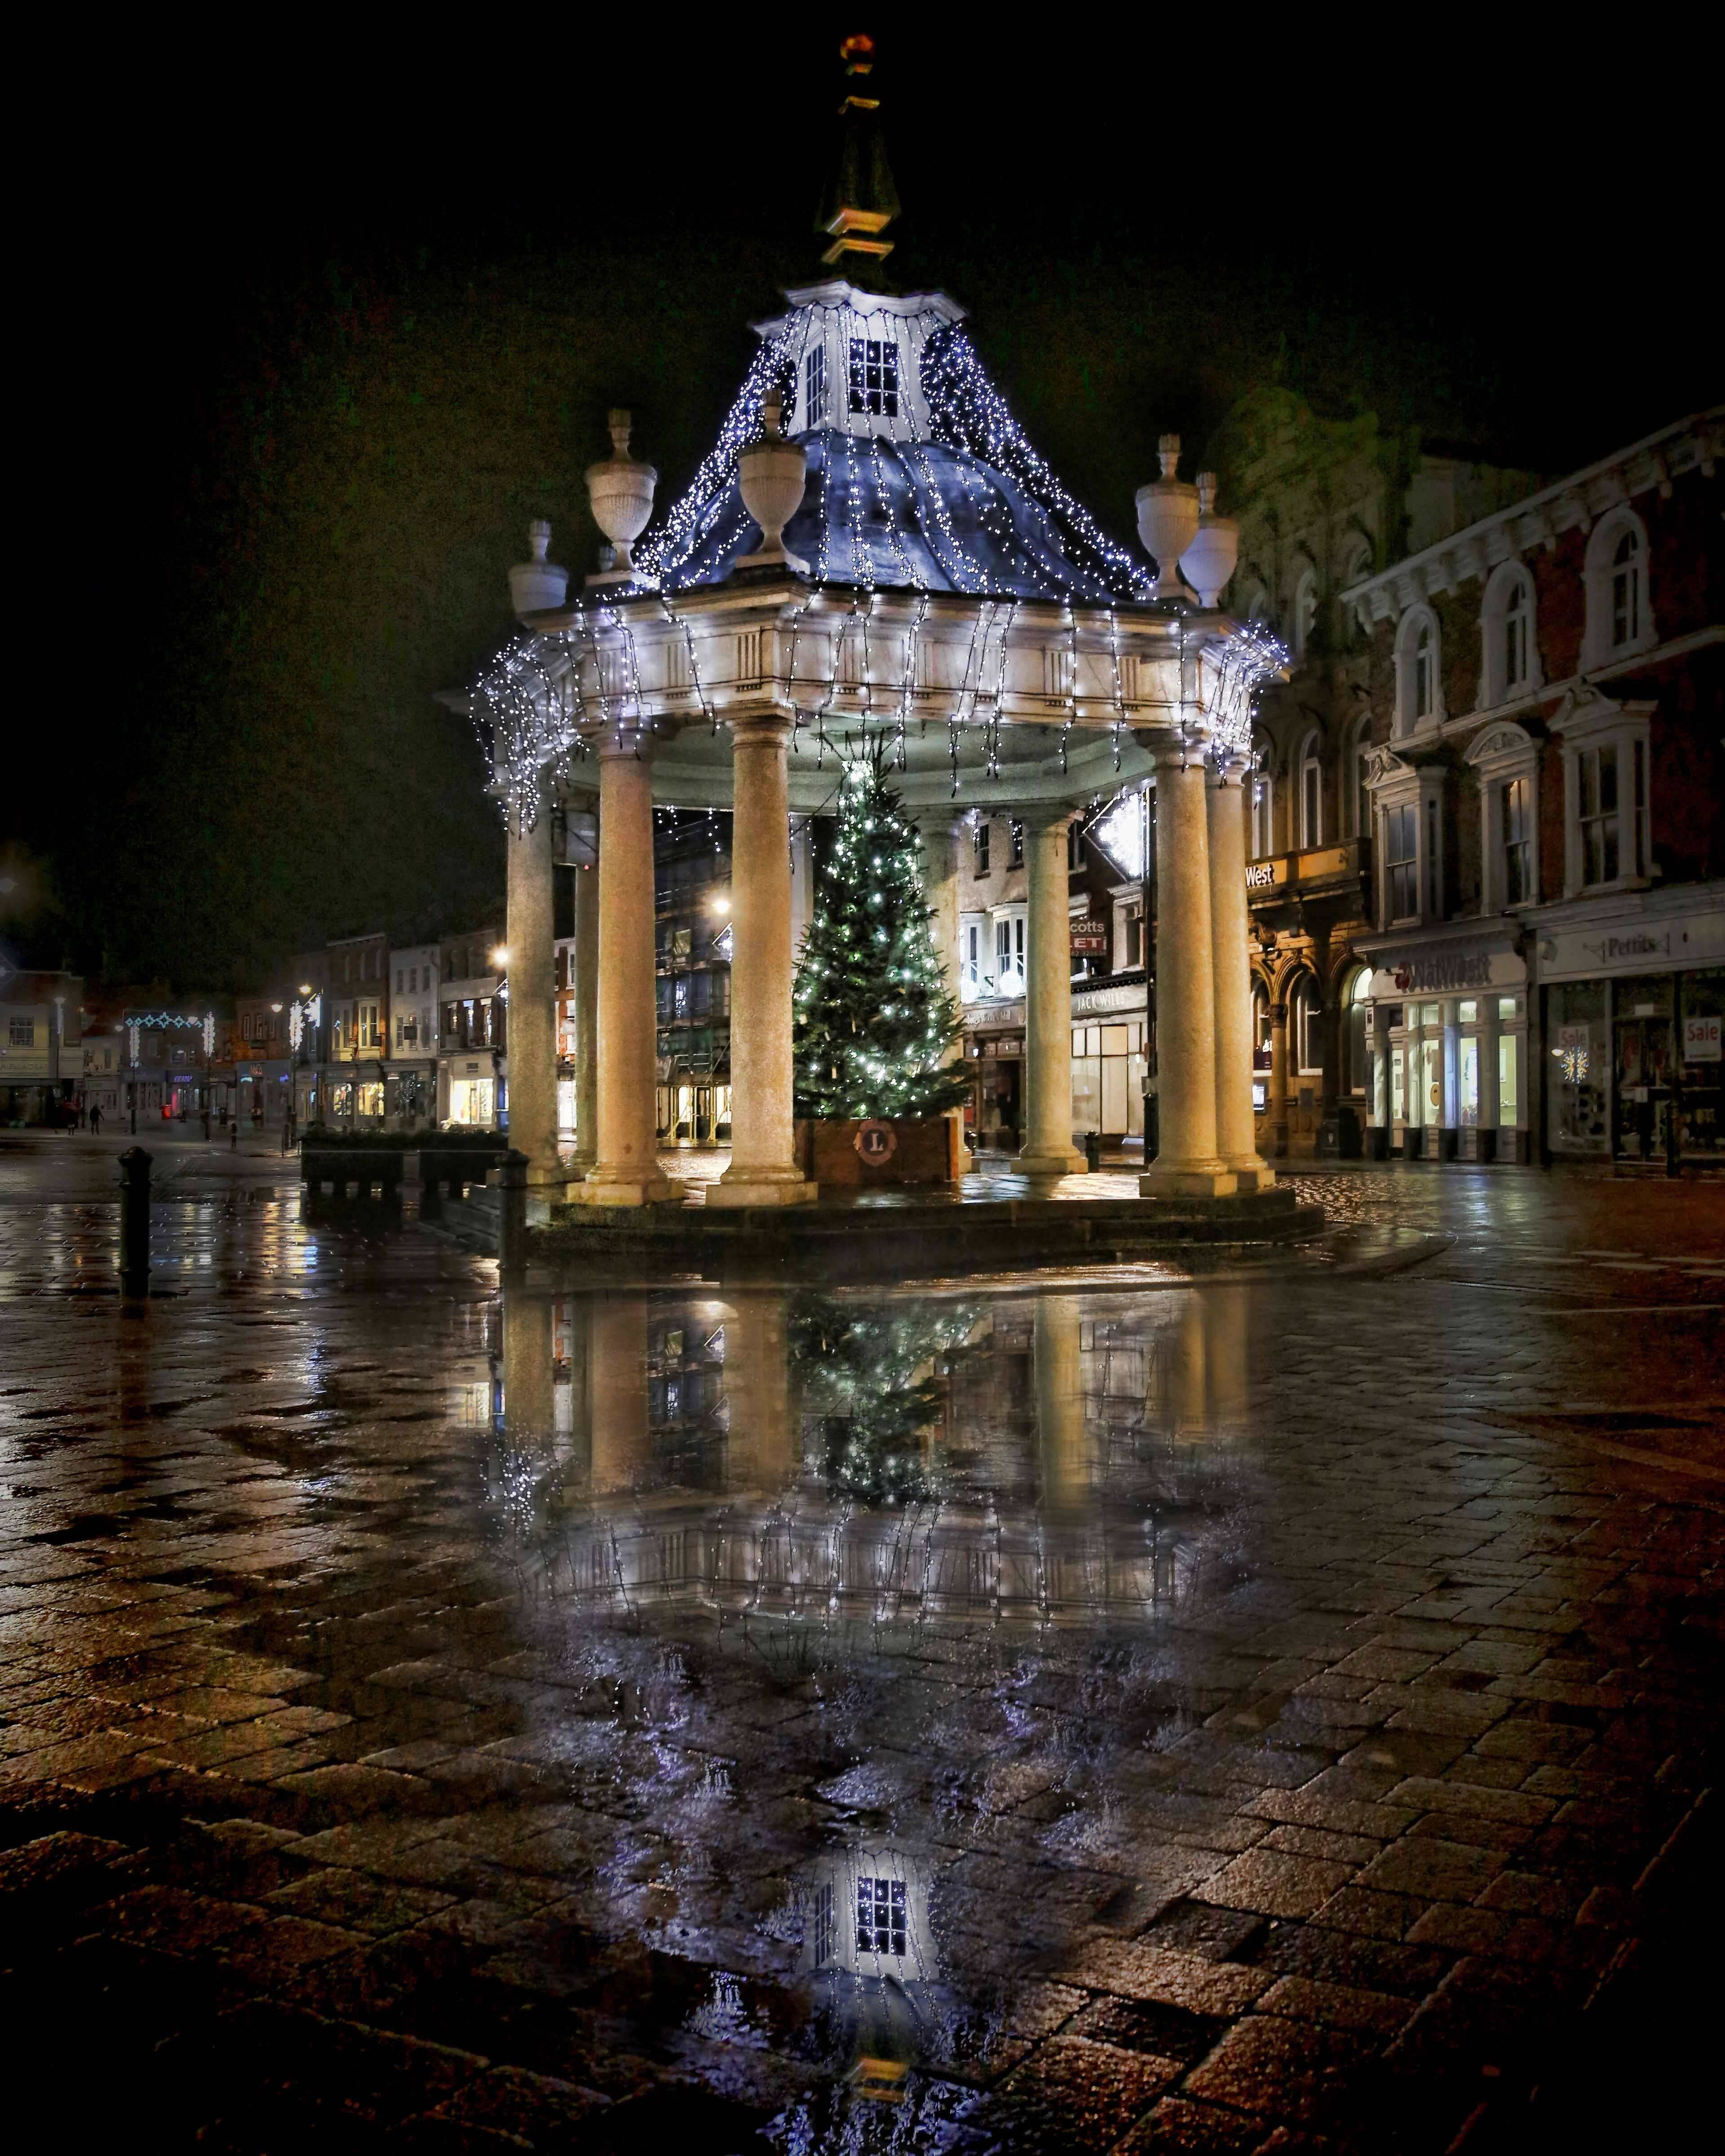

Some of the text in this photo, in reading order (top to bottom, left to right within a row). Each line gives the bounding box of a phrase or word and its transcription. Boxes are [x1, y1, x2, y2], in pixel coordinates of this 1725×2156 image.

[1070, 921, 1104, 933] cotts
[1070, 937, 1102, 948] ET
[1078, 991, 1125, 1011] JACK WILLS
[1561, 1028, 1587, 1047] Sale
[1688, 1021, 1718, 1041] Sale
[869, 1132, 884, 1152] L
